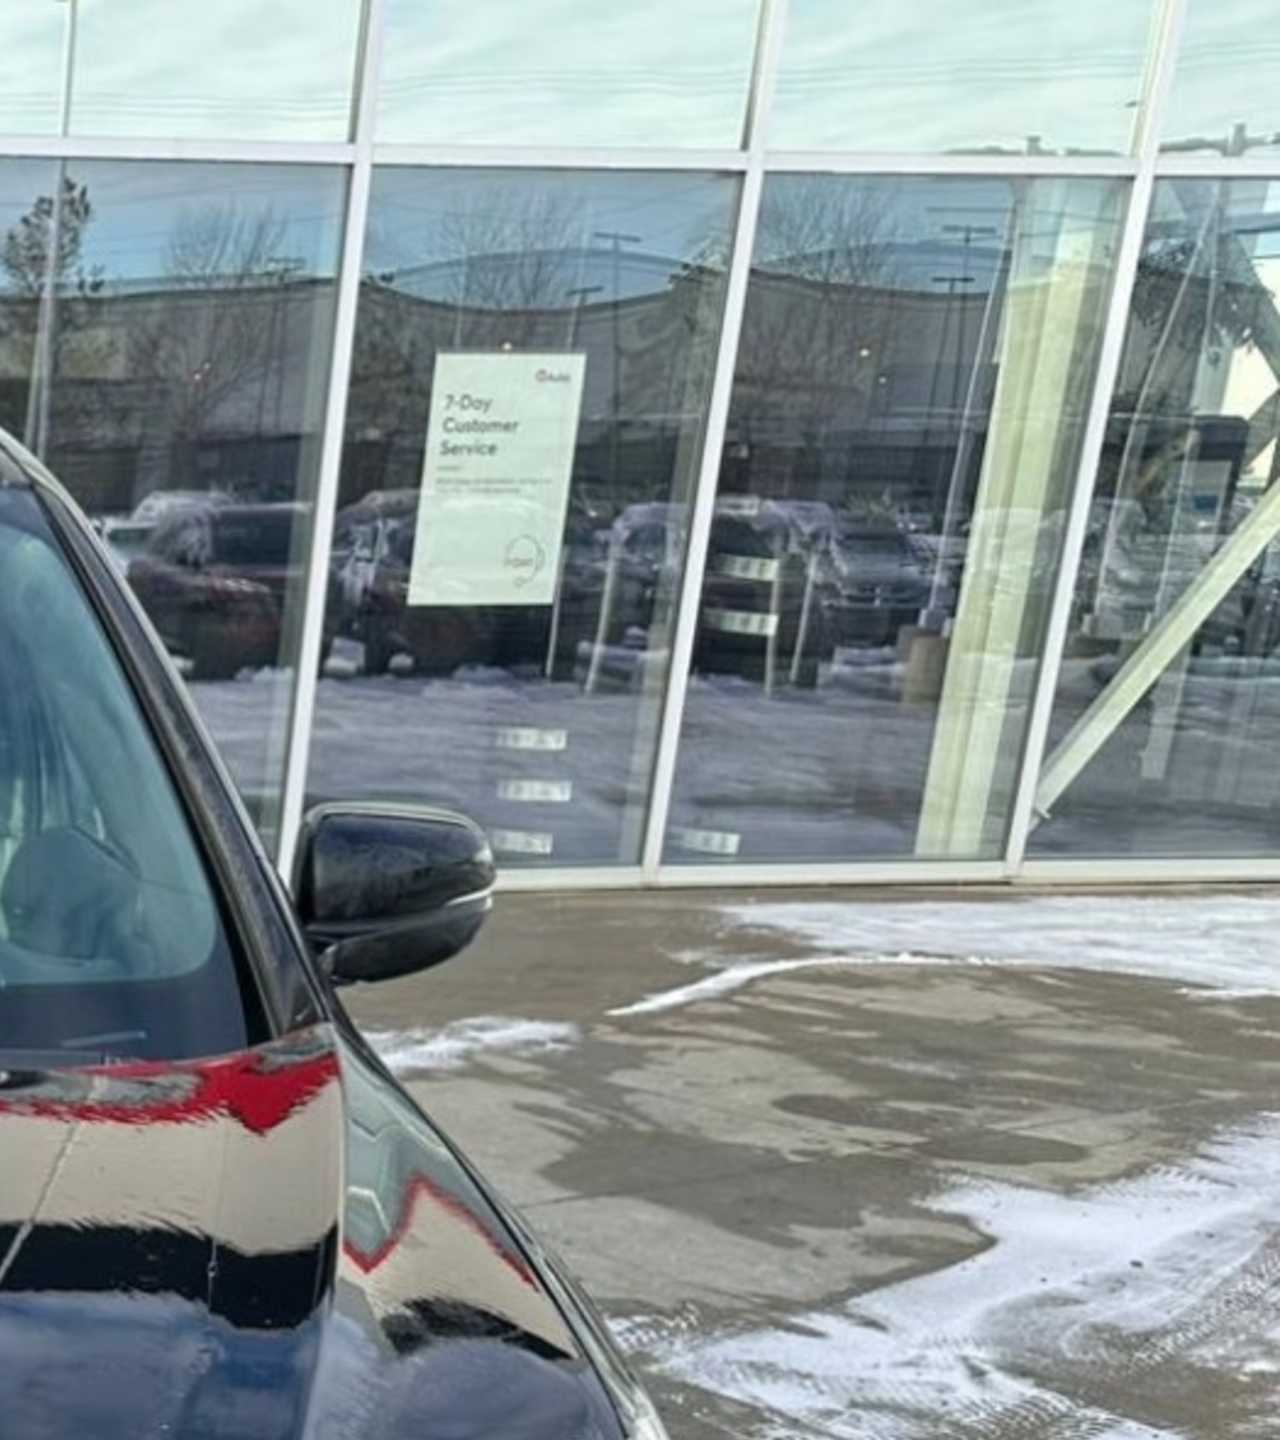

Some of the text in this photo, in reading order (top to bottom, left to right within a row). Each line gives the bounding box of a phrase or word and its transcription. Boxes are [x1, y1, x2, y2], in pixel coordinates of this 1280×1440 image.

[444, 394, 493, 413] 7-Day
[442, 417, 520, 433] Customer
[439, 440, 498, 457] Service
